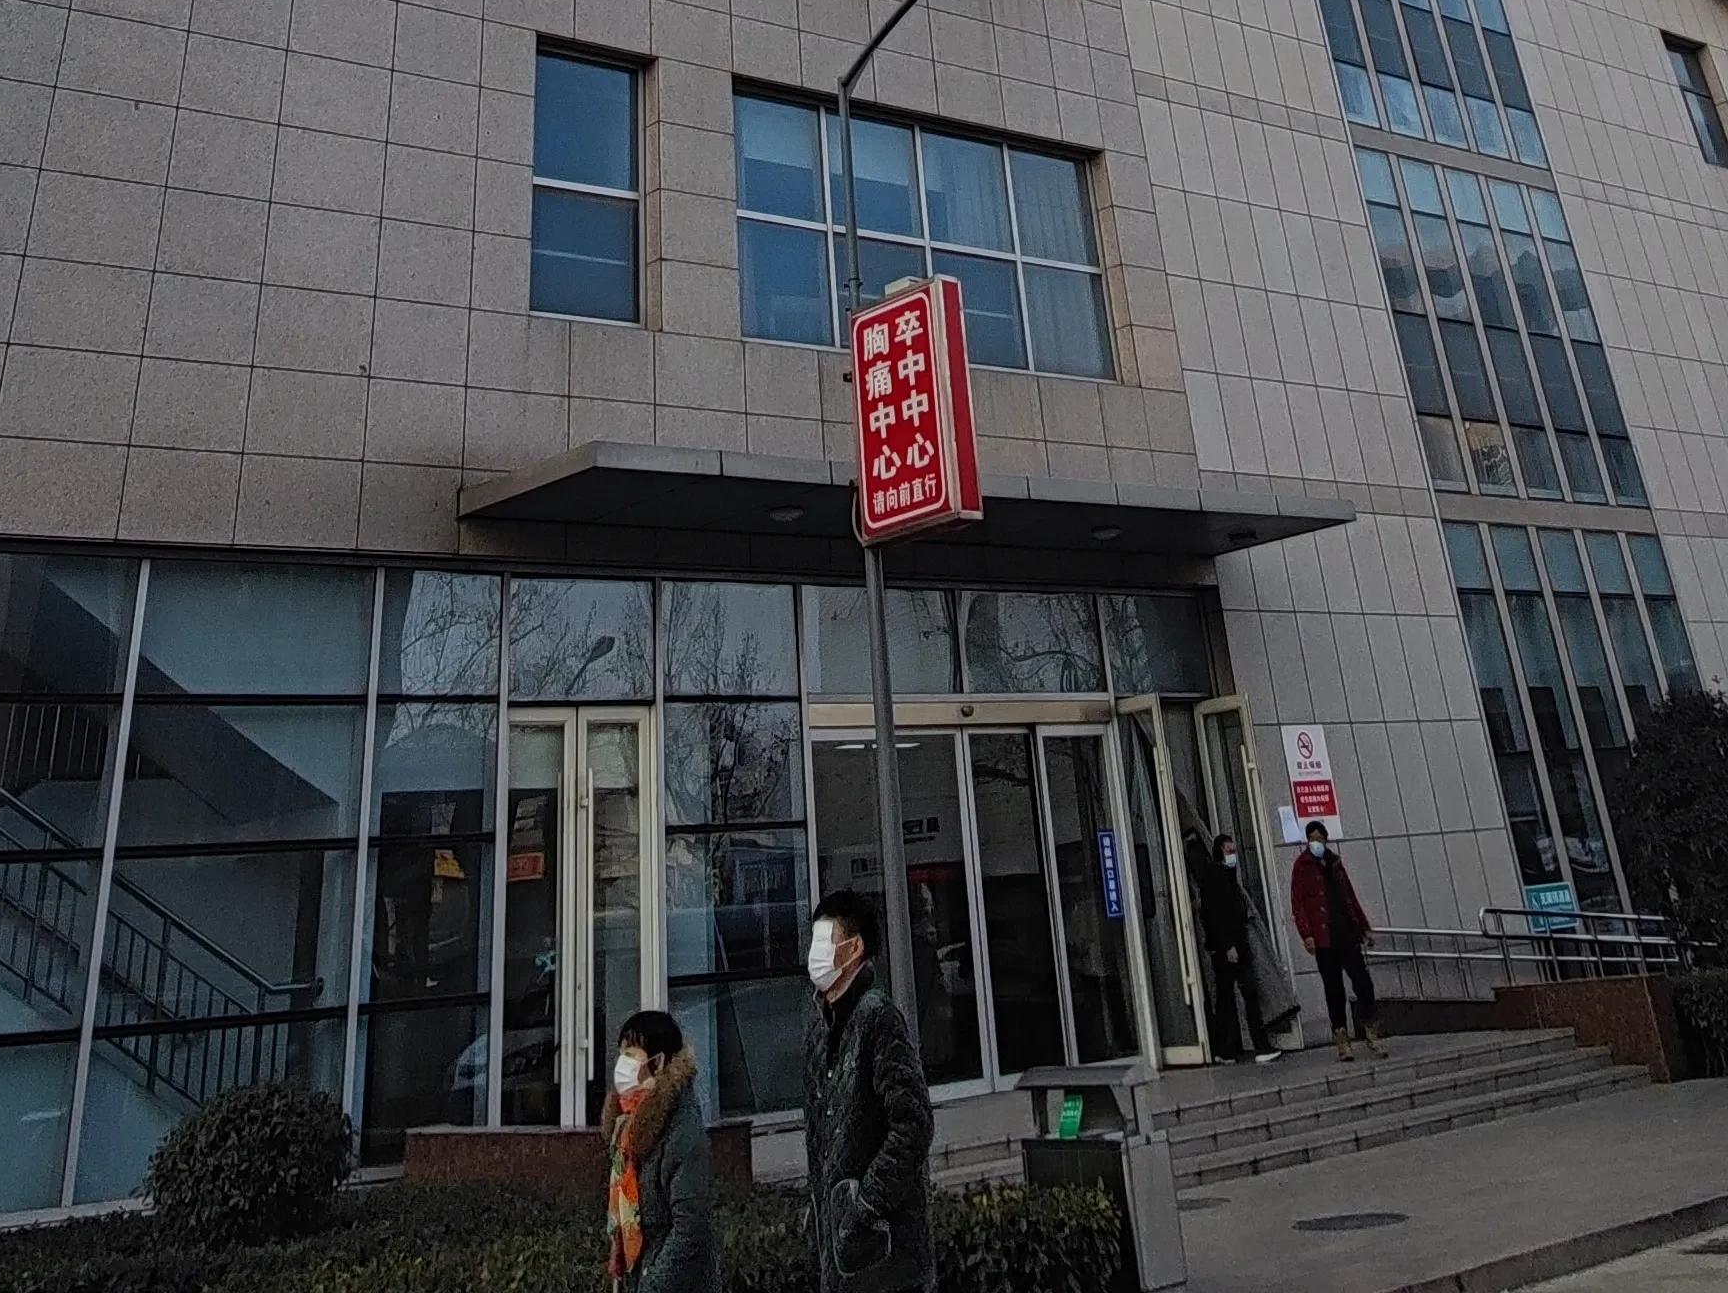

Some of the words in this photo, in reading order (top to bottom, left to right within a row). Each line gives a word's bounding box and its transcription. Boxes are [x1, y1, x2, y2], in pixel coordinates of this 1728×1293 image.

[863, 322, 902, 481] 胸痛中心
[894, 310, 934, 470] 卒中中心
[872, 473, 937, 515] 请向前直行
